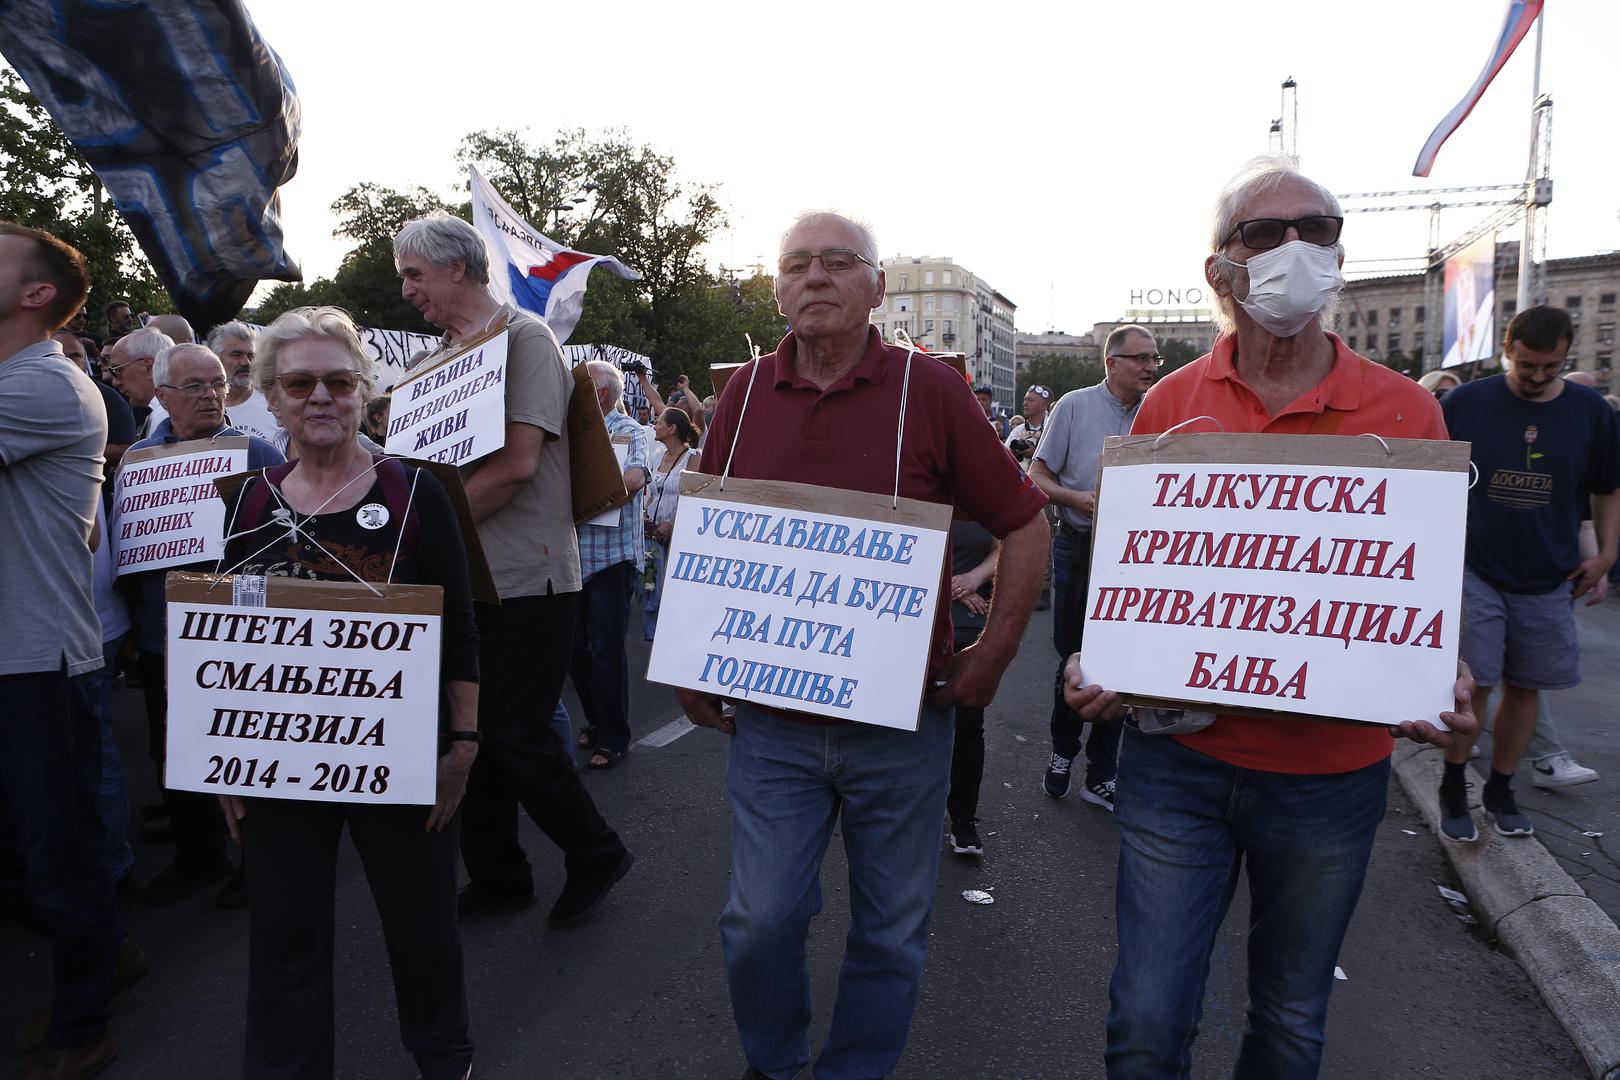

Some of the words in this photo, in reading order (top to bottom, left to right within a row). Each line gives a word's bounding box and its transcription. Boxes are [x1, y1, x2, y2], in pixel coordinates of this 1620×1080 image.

[1130, 288, 1209, 305] HONO
[410, 349, 483, 401] ВЕЋИНА
[388, 365, 502, 438] ПЕНЗИОНЕРА
[413, 408, 469, 452] ЖИВИ
[121, 456, 232, 488] КРИМИНАЦИЈА
[120, 482, 221, 513] ОПРИВРЕДНИ
[1152, 473, 1387, 515] ТАЈКУНСКА
[120, 522, 133, 540] И
[134, 512, 194, 537] ВОЈНИХ
[697, 507, 918, 564] УСКЛАЂИВАЊЕ
[118, 537, 205, 567] ЕНЗИОНЕРА
[1119, 530, 1415, 580] КРИМИНАЛНА
[671, 552, 796, 597] ПЕНЗИЈА
[795, 571, 840, 608] ДА
[845, 578, 928, 622] БУДЕ
[179, 612, 313, 646] ШТЕТА
[323, 619, 427, 651] ЗБОГ
[711, 607, 771, 644] ДВА
[774, 617, 854, 657] ПУТА
[1090, 587, 1443, 649] ПРИВАТИЗАЦИЈА
[196, 660, 403, 699] СМАЊЕЊА
[699, 654, 858, 709] ГОДИШЊЕ
[1185, 652, 1308, 699] БАЊА
[207, 709, 385, 746] ПЕНЗИЈА
[204, 755, 279, 788] 2014
[309, 763, 390, 794] 2018
